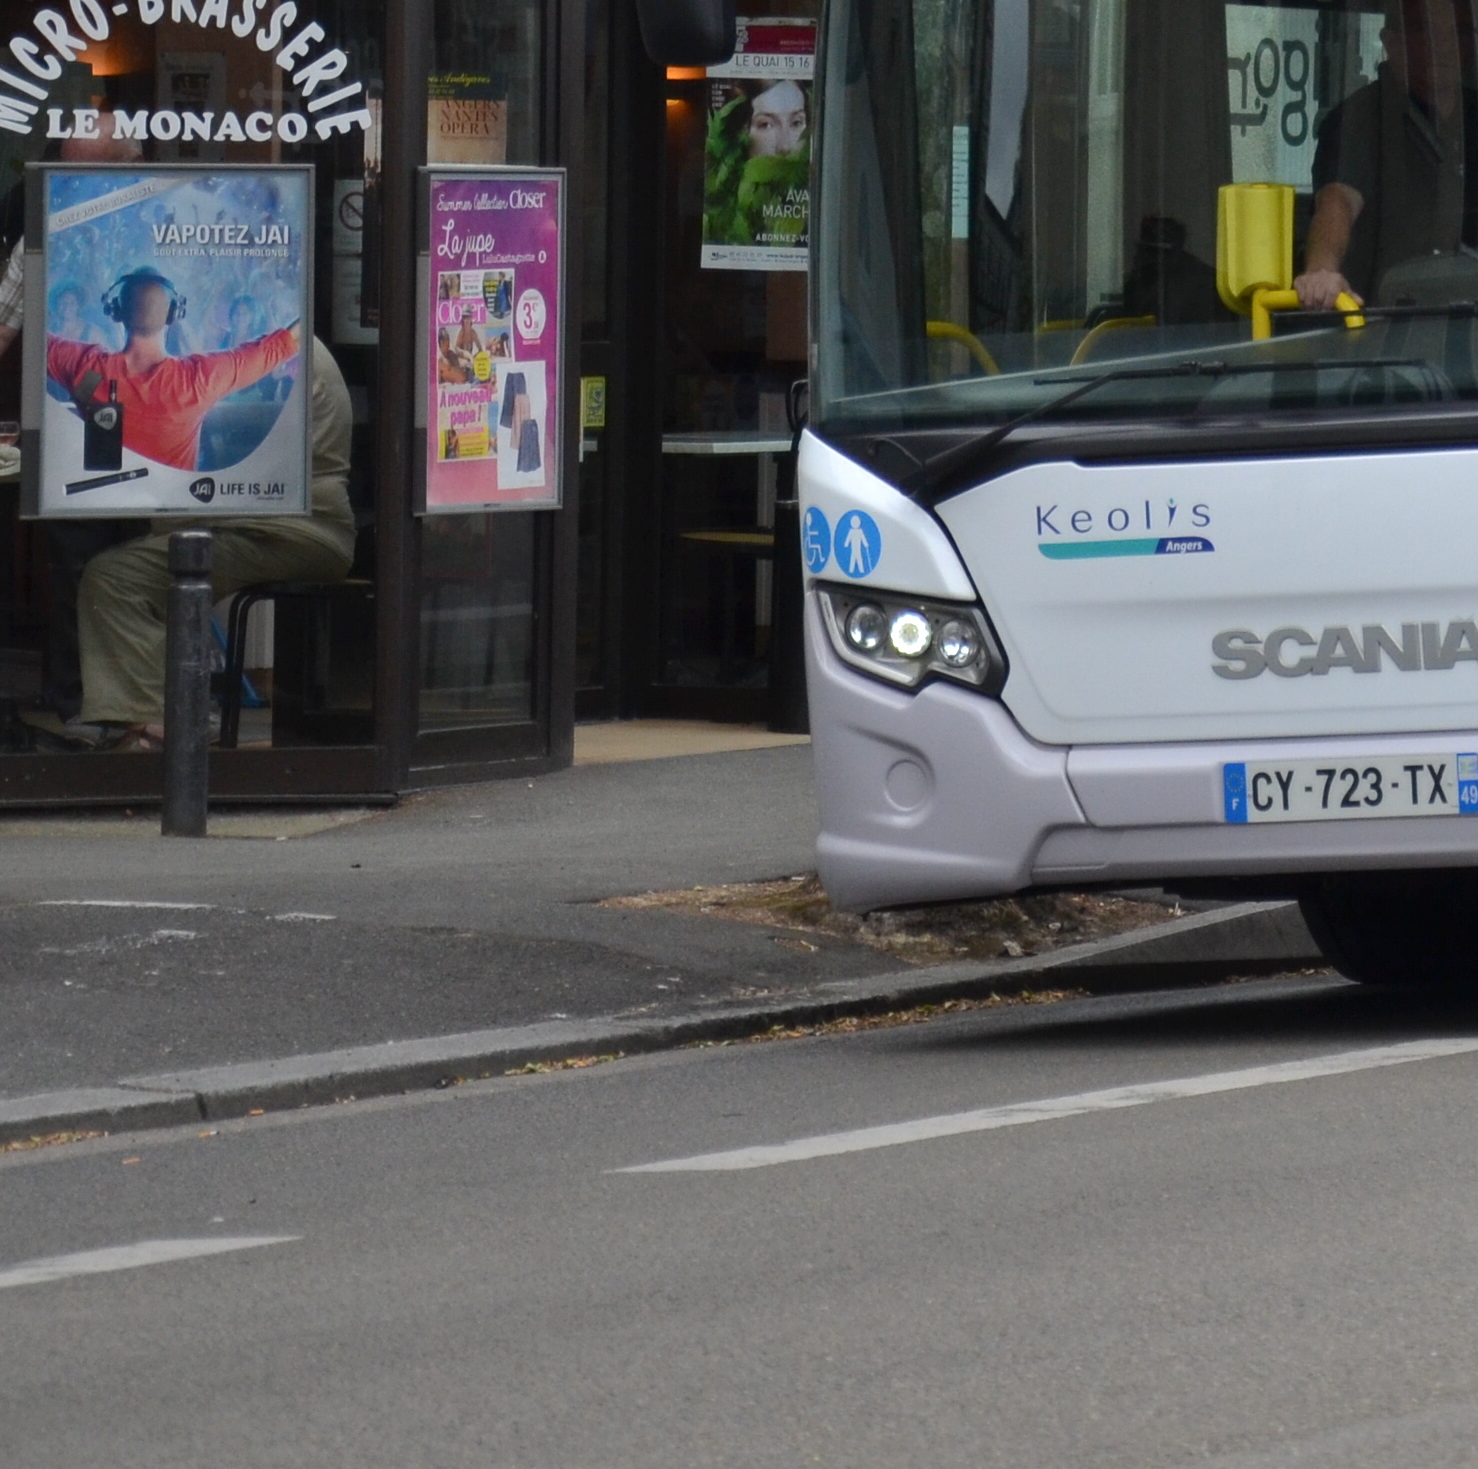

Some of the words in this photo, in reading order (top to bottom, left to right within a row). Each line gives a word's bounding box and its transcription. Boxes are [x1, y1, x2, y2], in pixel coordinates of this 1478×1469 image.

[735, 55, 749, 67] LE
[753, 55, 779, 67] QUAI
[784, 56, 795, 68] 15
[799, 57, 810, 68] 16
[46, 108, 101, 140] LE
[112, 109, 309, 144] MONACO
[509, 188, 547, 209] Closer
[152, 224, 250, 245] VAPOTEZ
[254, 225, 290, 245] JAI
[437, 218, 463, 260] La
[461, 229, 495, 268] jupe
[438, 301, 485, 325] Cloer
[193, 481, 212, 496] JAI
[220, 482, 245, 495] LIFE
[249, 482, 260, 495] IS
[264, 482, 285, 495] JAI
[1036, 498, 1212, 536] Keolis
[1165, 539, 1203, 554] Angers
[1231, 797, 1240, 810] F
[1460, 783, 1478, 805] 49
